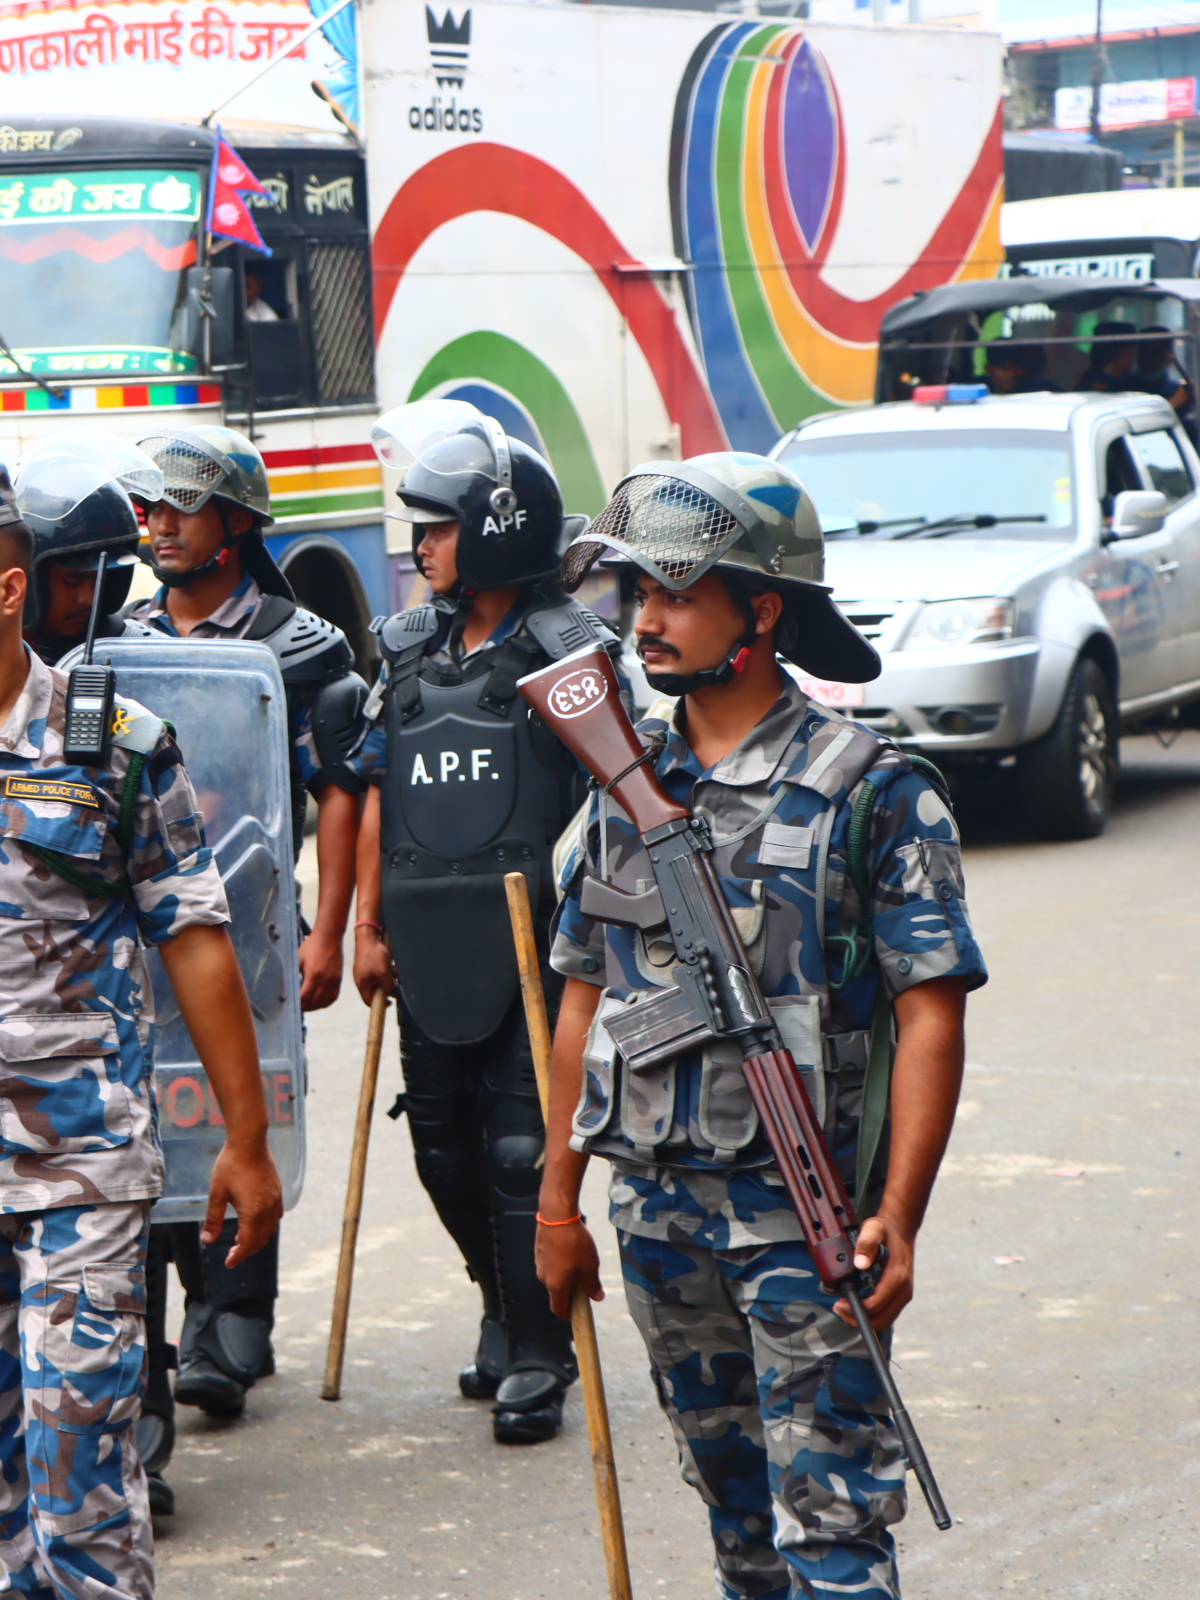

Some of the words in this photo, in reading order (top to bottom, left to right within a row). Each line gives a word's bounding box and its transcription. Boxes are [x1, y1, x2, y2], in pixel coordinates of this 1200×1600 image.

[124, 9, 185, 66] माई
[189, 7, 236, 60] की
[239, 21, 312, 61] जय
[408, 96, 483, 133] adidas
[29, 178, 77, 213] की
[81, 182, 147, 211] जय
[482, 509, 527, 537] APF
[410, 748, 500, 786] A.P.F.
[10, 782, 40, 793] ARMED
[42, 785, 72, 797] POLICE
